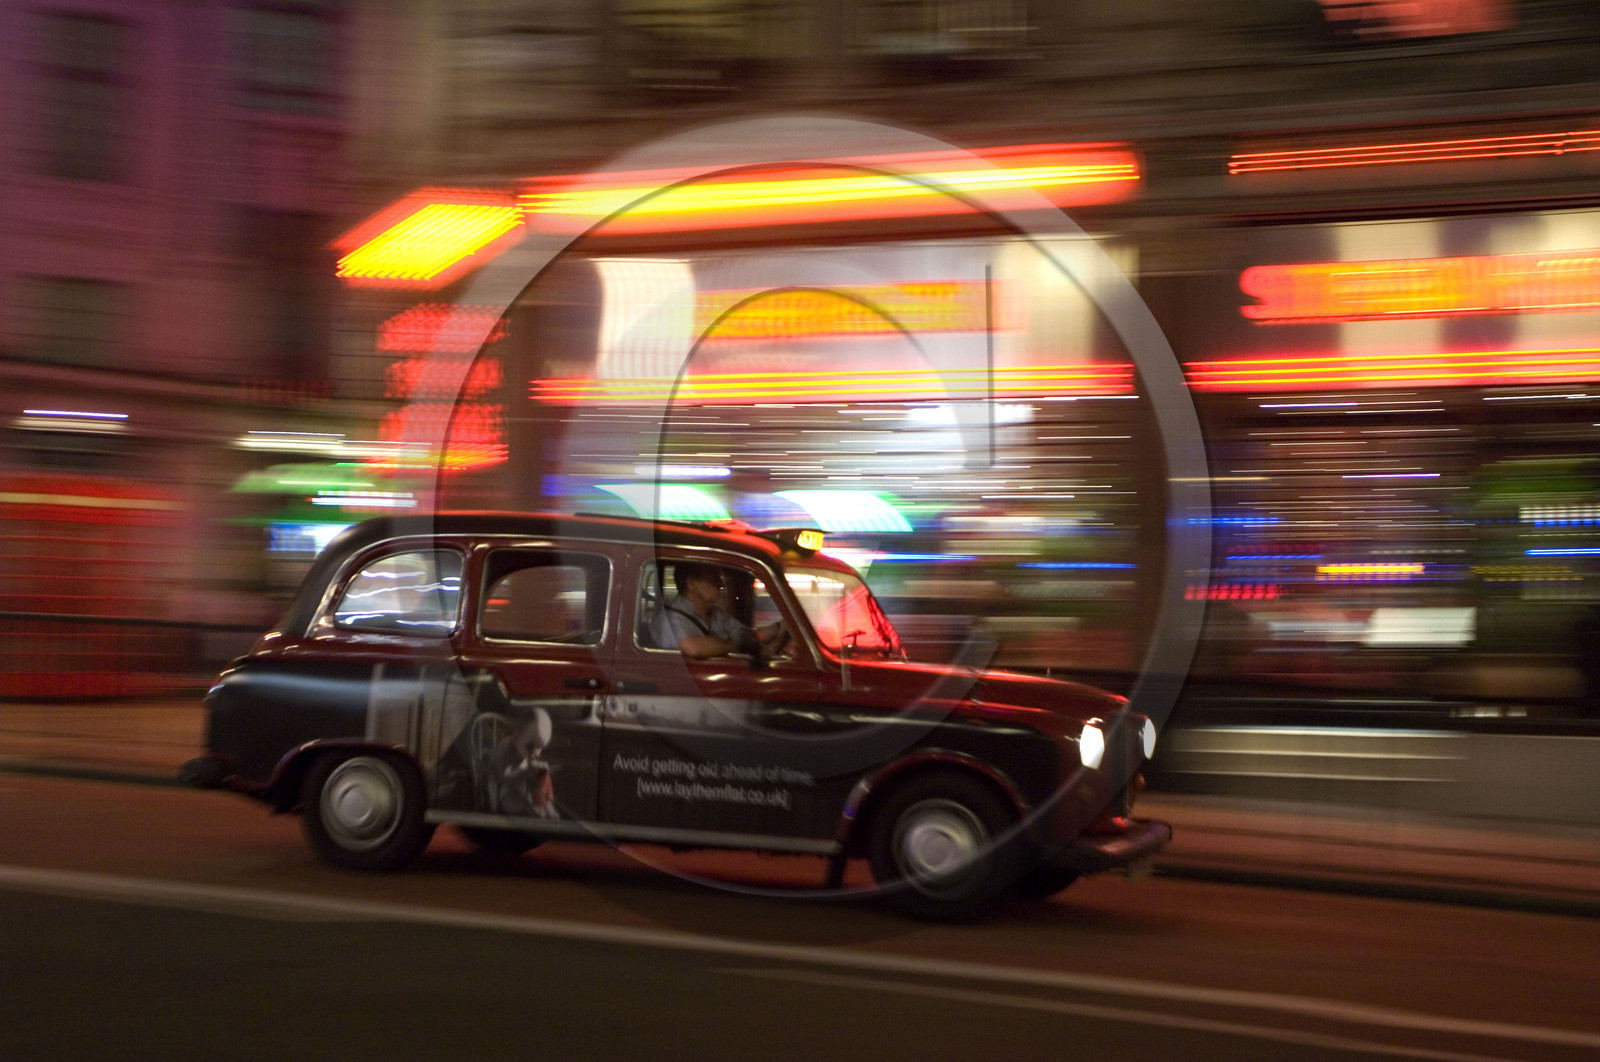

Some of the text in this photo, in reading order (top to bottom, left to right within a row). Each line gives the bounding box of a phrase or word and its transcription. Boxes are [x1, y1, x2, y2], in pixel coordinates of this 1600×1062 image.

[613, 752, 649, 774] Avoid
[651, 757, 698, 780] getting
[698, 761, 720, 778] old
[720, 762, 763, 782] ahead
[764, 765, 781, 783] of
